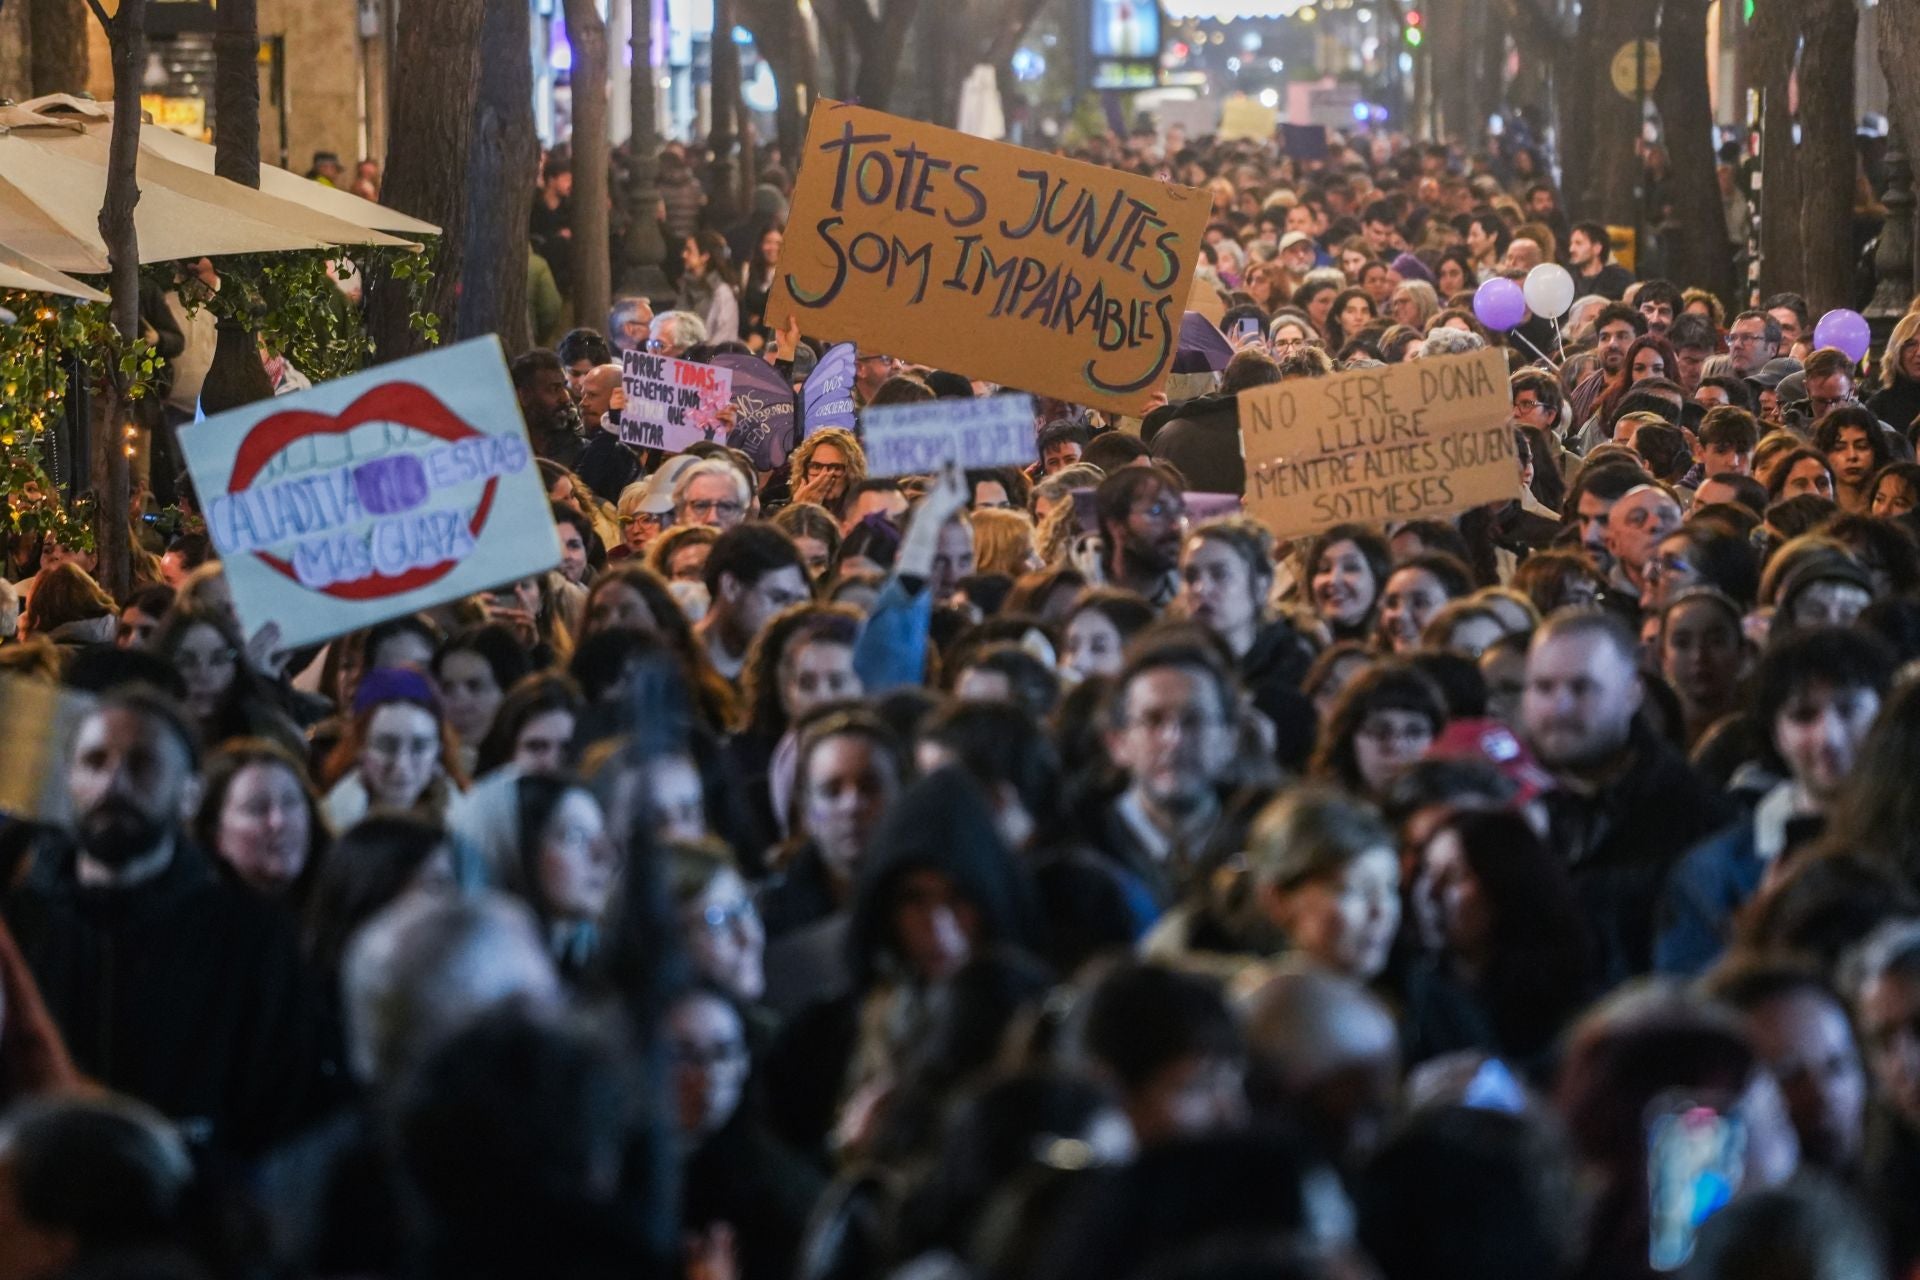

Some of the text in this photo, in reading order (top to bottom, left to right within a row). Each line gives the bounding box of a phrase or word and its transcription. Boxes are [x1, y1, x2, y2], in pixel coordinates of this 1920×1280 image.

[820, 120, 1182, 291] TOTES JUNTES
[785, 216, 1173, 394] SOM IMPARABLES
[623, 350, 667, 381] PORQUE
[622, 377, 701, 408] TENEMOS UNA
[667, 405, 686, 426] QUE
[1250, 390, 1297, 434] NO
[1420, 359, 1496, 405] DONA
[621, 418, 664, 447] CONTAR
[1317, 408, 1430, 453] LLIURE
[1254, 453, 1358, 499] MENTRE
[1364, 441, 1438, 483] ALTRES
[1311, 475, 1455, 523] SOTMESES
